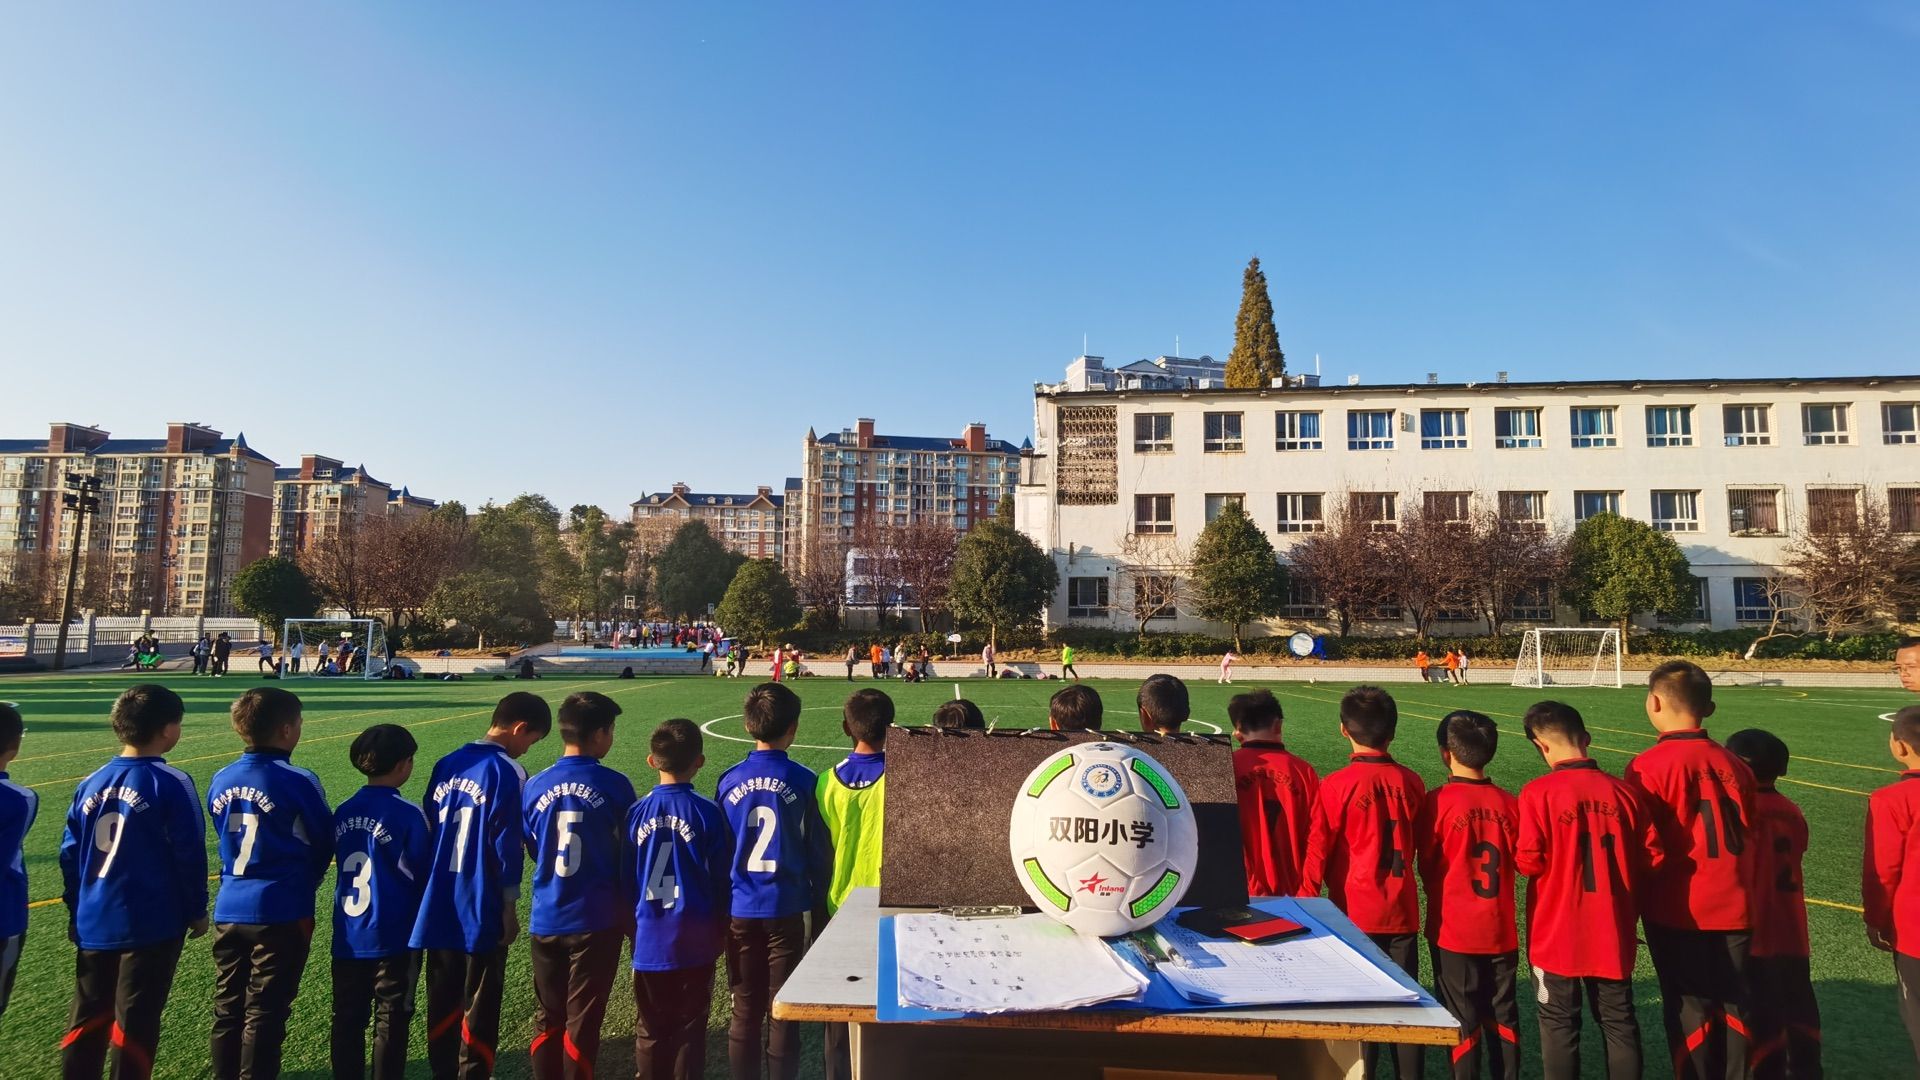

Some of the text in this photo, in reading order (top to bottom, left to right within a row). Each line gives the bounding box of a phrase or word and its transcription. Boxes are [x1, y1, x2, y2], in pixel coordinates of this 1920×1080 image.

[94, 811, 127, 879] 9
[228, 813, 259, 876] 7
[555, 811, 584, 878] 5
[747, 805, 777, 873] 2
[1048, 816, 1155, 848] 双阳小学
[341, 851, 373, 917] 3
[645, 842, 680, 909] 4
[1471, 841, 1501, 899] 3
